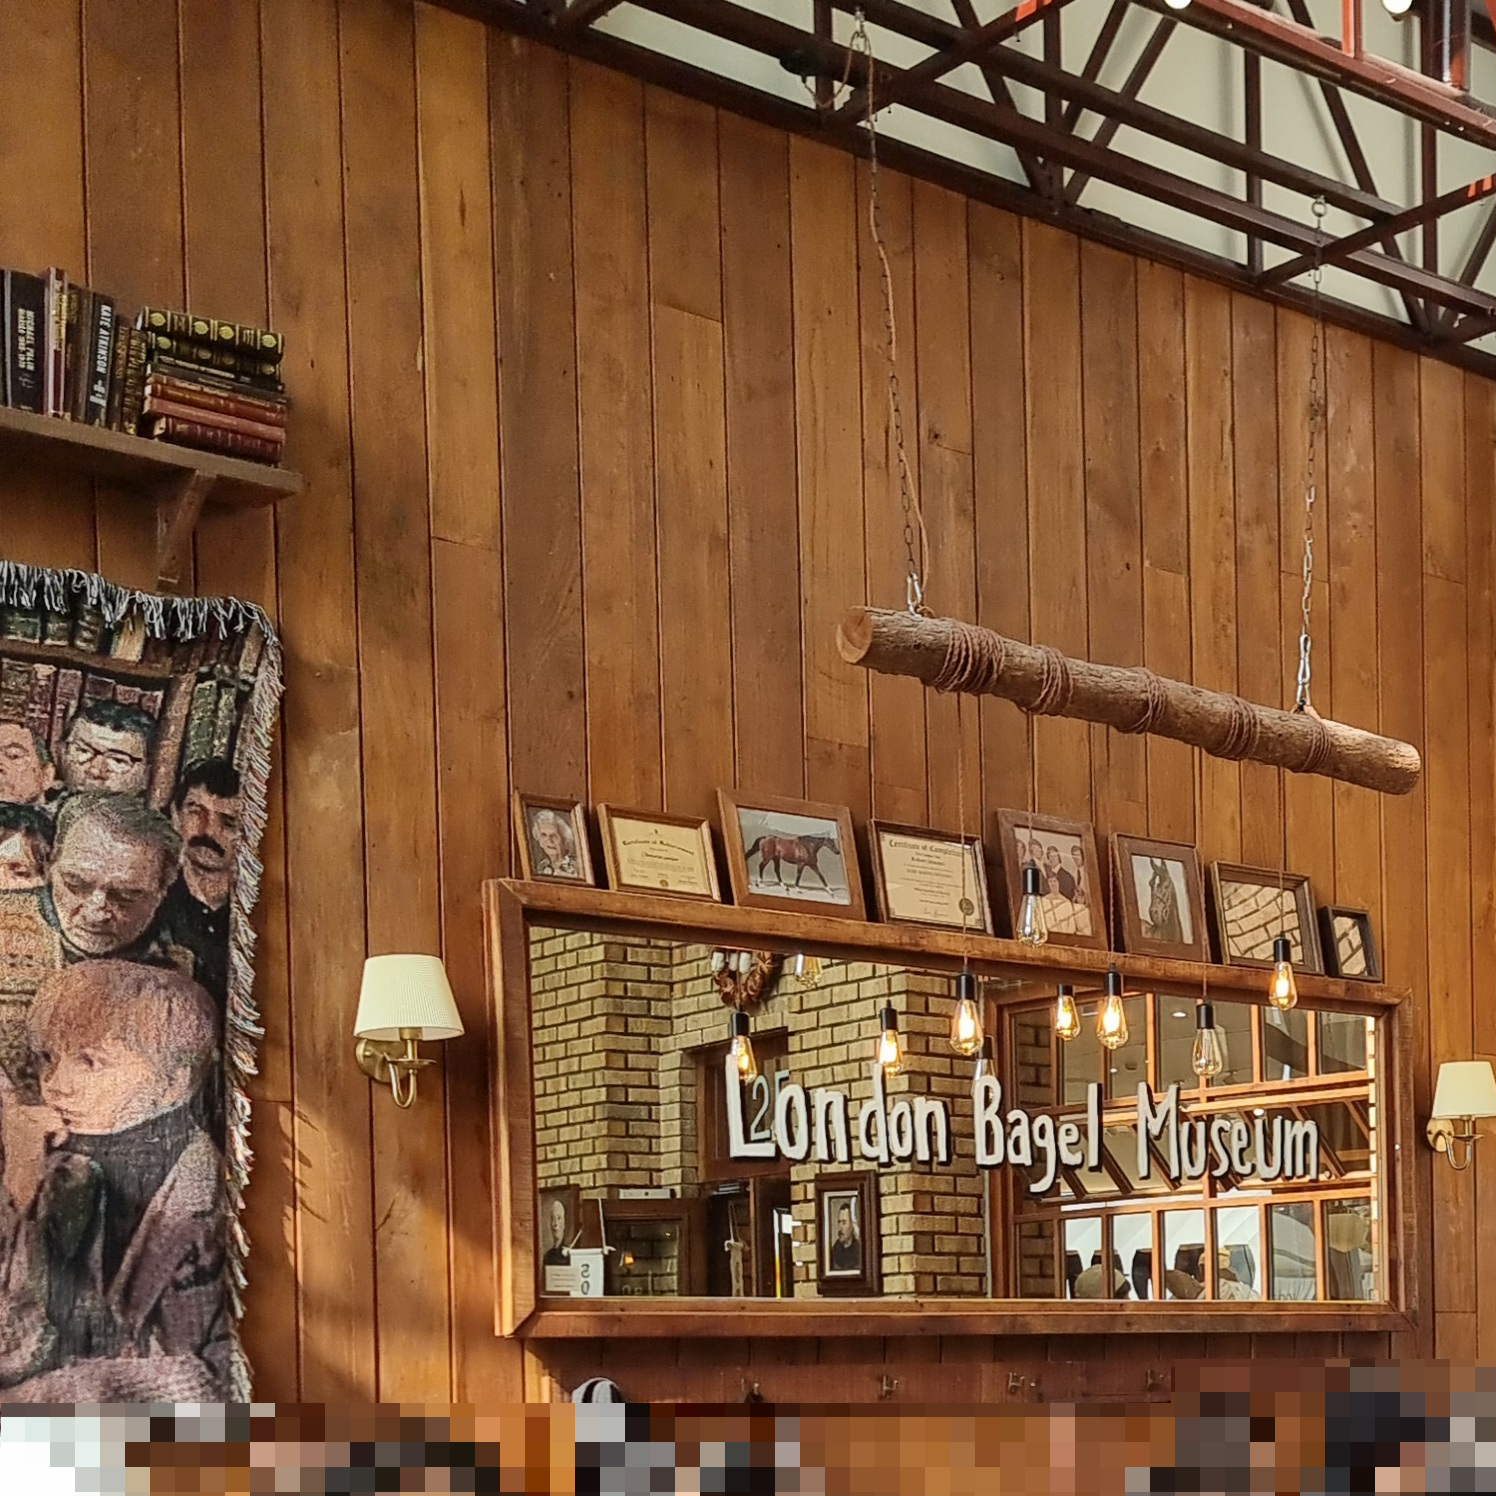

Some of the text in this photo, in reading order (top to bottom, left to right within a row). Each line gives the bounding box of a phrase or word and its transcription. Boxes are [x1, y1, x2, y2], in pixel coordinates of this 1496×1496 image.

[99, 304, 112, 328] KATE
[96, 328, 110, 374] ATKINSON
[725, 1054, 1319, 1193] London Bagel Museum
